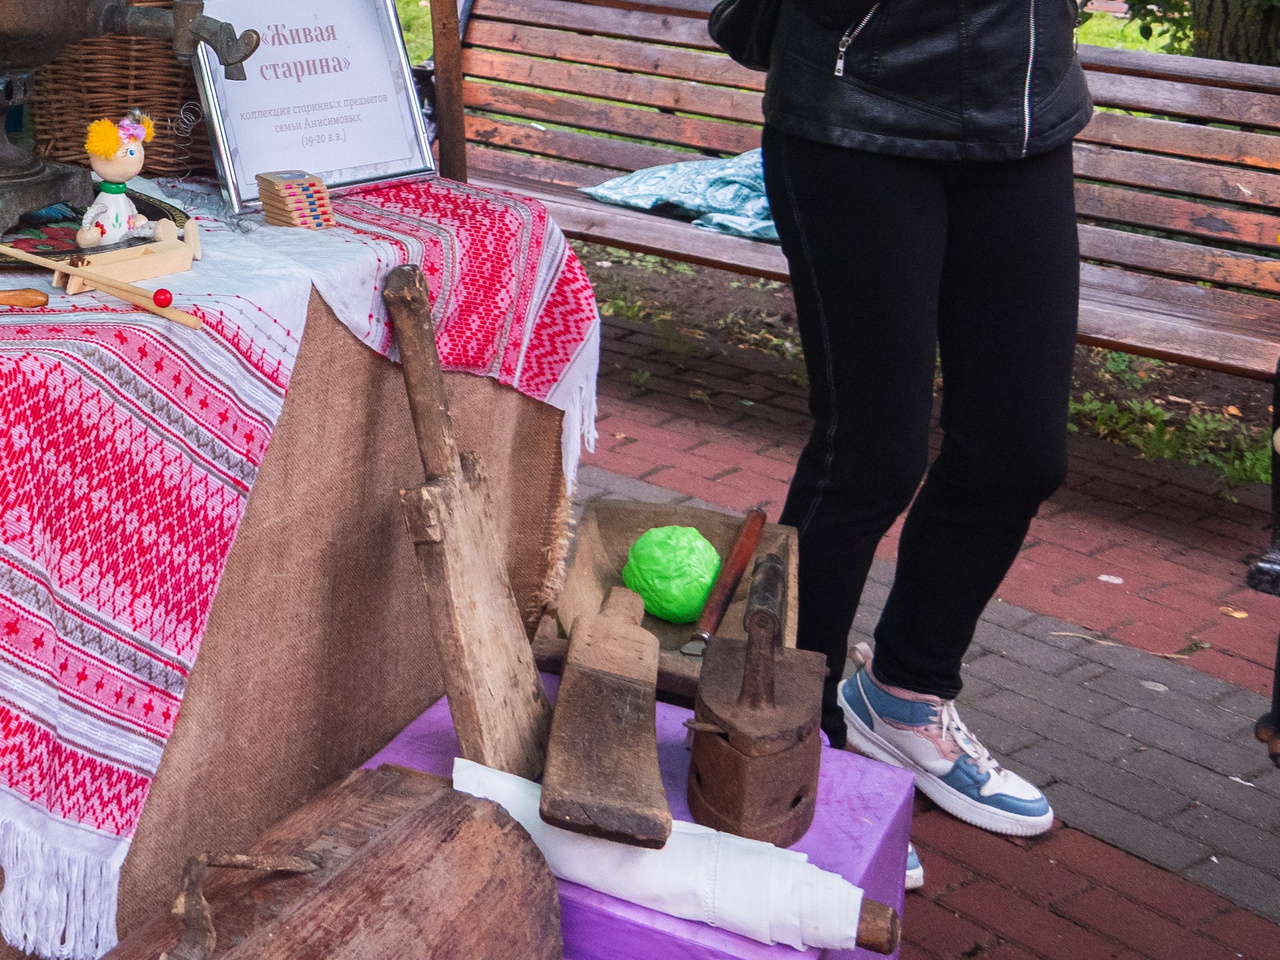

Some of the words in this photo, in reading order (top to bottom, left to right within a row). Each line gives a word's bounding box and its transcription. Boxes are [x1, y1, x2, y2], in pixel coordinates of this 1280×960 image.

[260, 23, 337, 47] «Живая
[259, 55, 351, 83] старина»
[239, 106, 291, 121] коллекция
[292, 100, 342, 116] старинных
[343, 94, 388, 110] предметов
[274, 120, 302, 133] семьи
[304, 113, 362, 130] Анисимовых
[301, 133, 326, 149] (19-20
